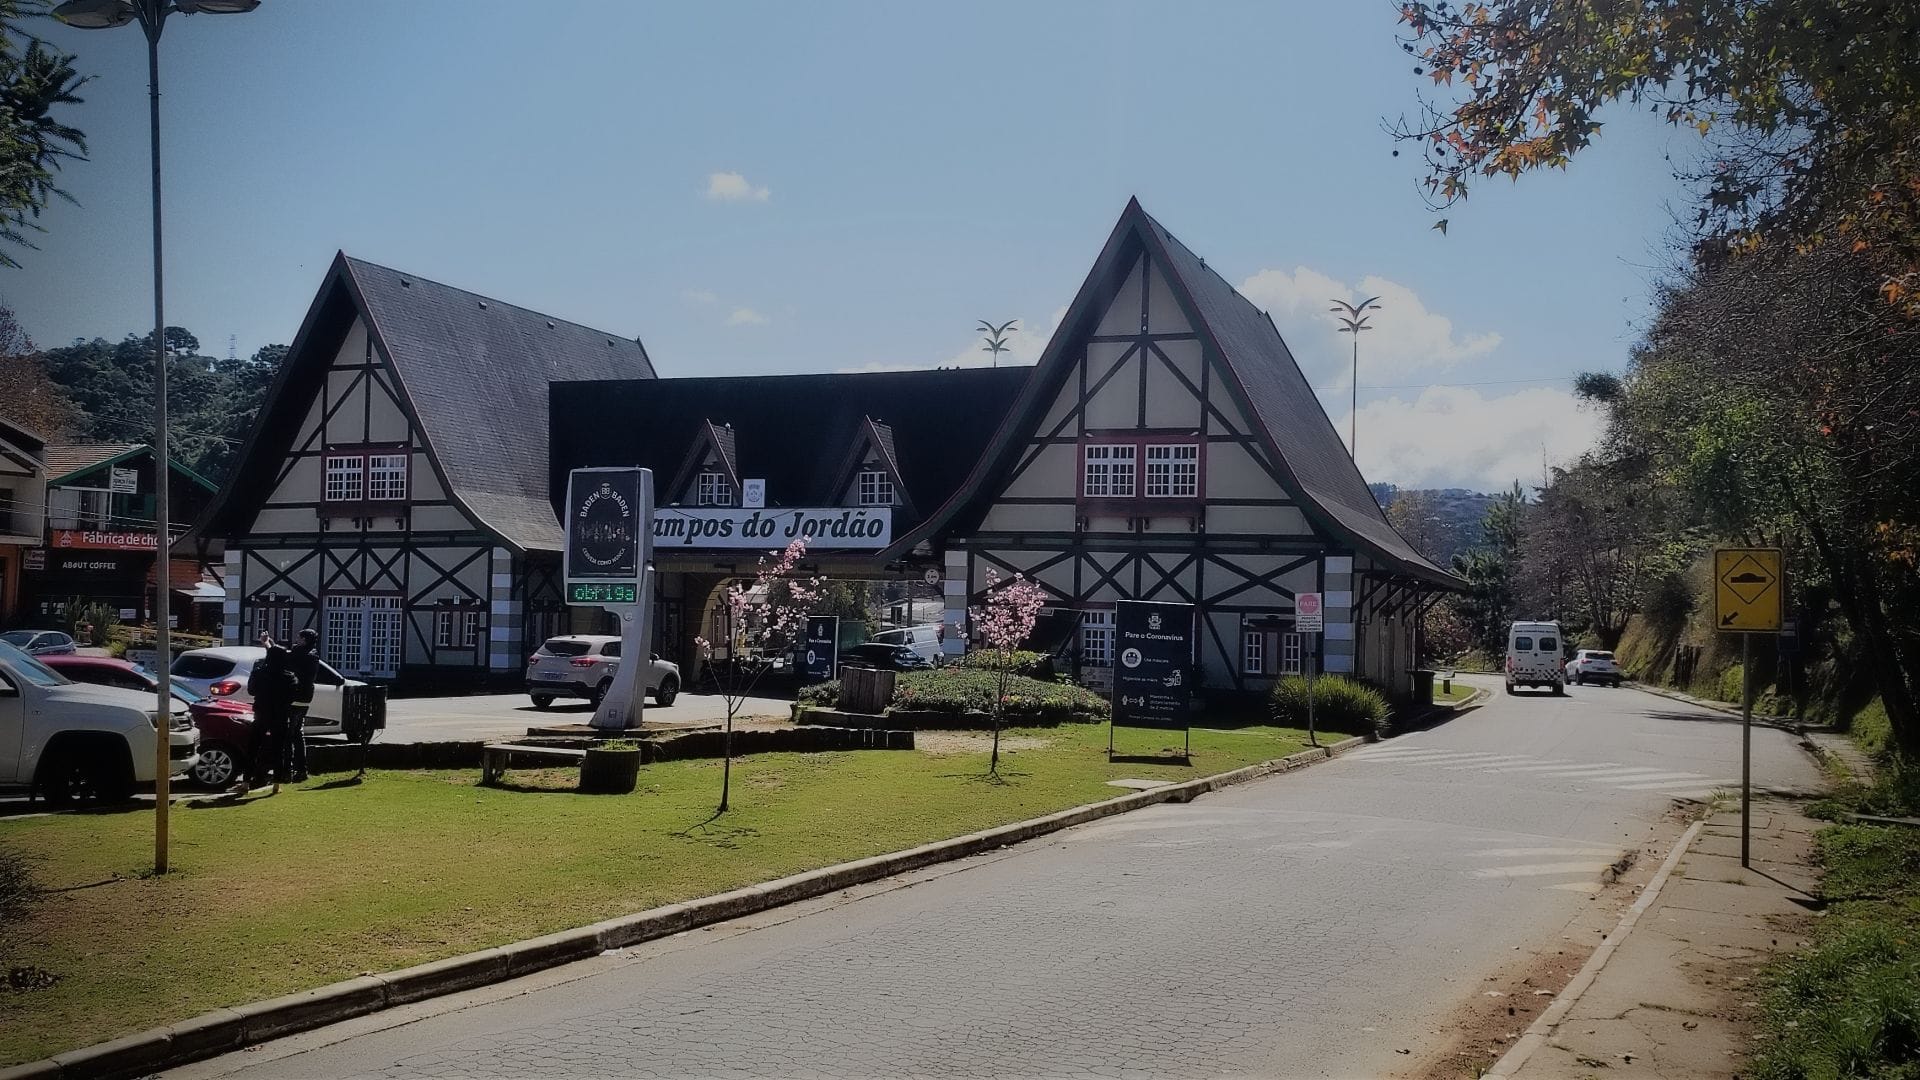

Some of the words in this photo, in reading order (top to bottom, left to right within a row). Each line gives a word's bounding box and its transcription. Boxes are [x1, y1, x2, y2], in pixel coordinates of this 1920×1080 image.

[580, 491, 600, 517] BADEN
[611, 490, 630, 517] BADEN
[82, 531, 124, 545] Fábrica
[126, 533, 139, 545] de
[653, 518, 733, 545] ampos
[741, 511, 776, 538] do
[784, 511, 884, 538] Jordão
[1125, 631, 1139, 639] Pare
